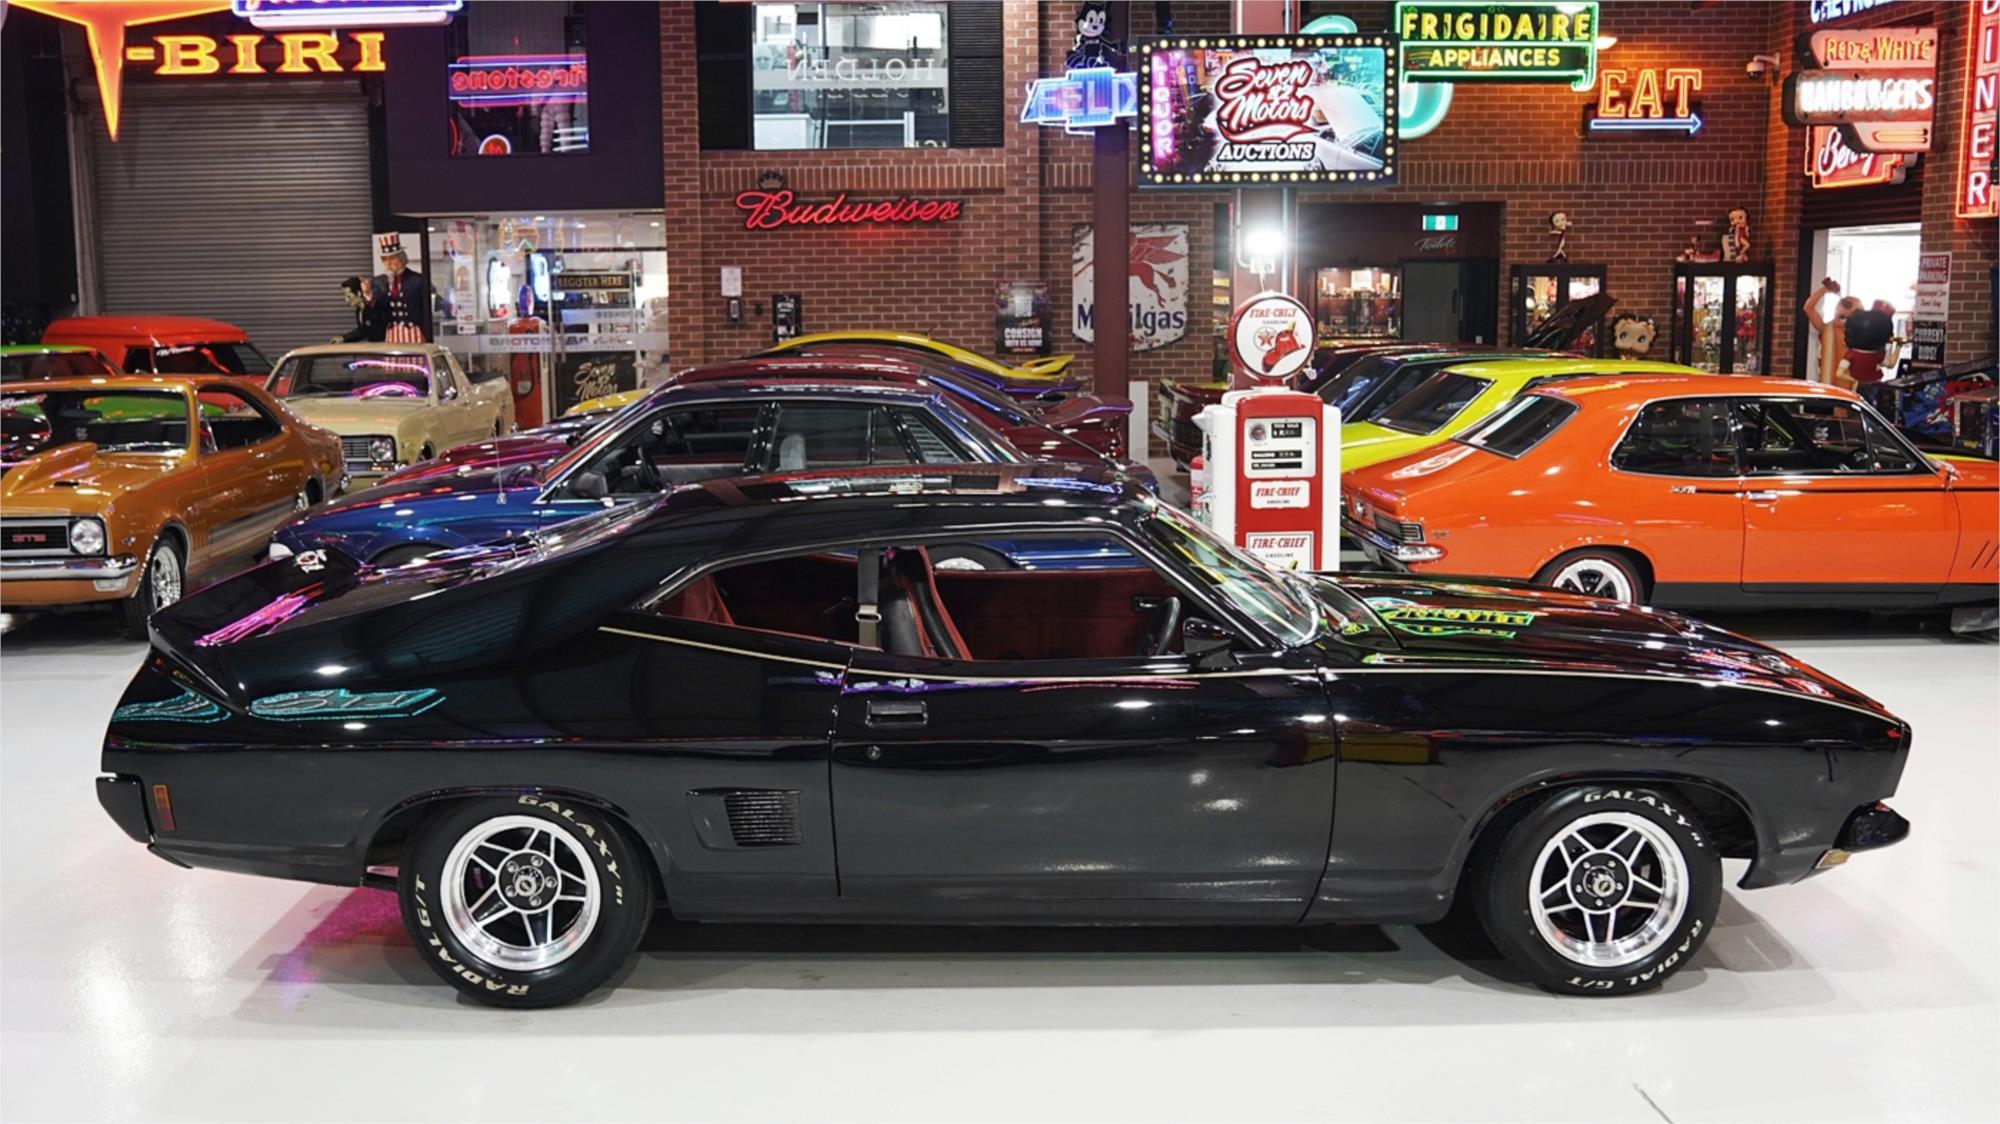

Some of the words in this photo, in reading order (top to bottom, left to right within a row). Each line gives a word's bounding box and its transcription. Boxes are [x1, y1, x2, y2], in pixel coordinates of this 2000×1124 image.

[1402, 13, 1590, 40] FRIGIDAIRE
[1429, 48, 1561, 67] APPLIANCES
[1825, 38, 1857, 60] RED
[1860, 42, 1872, 63] &
[1873, 36, 1931, 61] WHITE
[1217, 59, 1309, 98] Seven
[1600, 69, 1701, 117] EAT
[1801, 78, 1933, 112] HAMBURGERS
[1152, 55, 1173, 158] LIQUOR
[1219, 93, 1311, 130] Motors
[1218, 143, 1314, 161] AUCTIONS
[735, 190, 961, 229] Budweiser
[1921, 257, 1947, 268] PRIVATE
[557, 276, 599, 288] REGISTER
[600, 276, 623, 287] HERE
[1004, 327, 1043, 339] CONSIGN
[1078, 303, 1185, 337] Milgas
[1256, 487, 1300, 497] FIRE-CHIEF
[1252, 538, 1307, 549] FIRE-CHIEF
[1583, 790, 1692, 828] GALAXY
[517, 794, 621, 881] GALAXY
[415, 872, 432, 928] G/T
[428, 931, 530, 996] RADIAL
[1624, 919, 1704, 986] RADIAL
[1565, 976, 1615, 990] G/T
